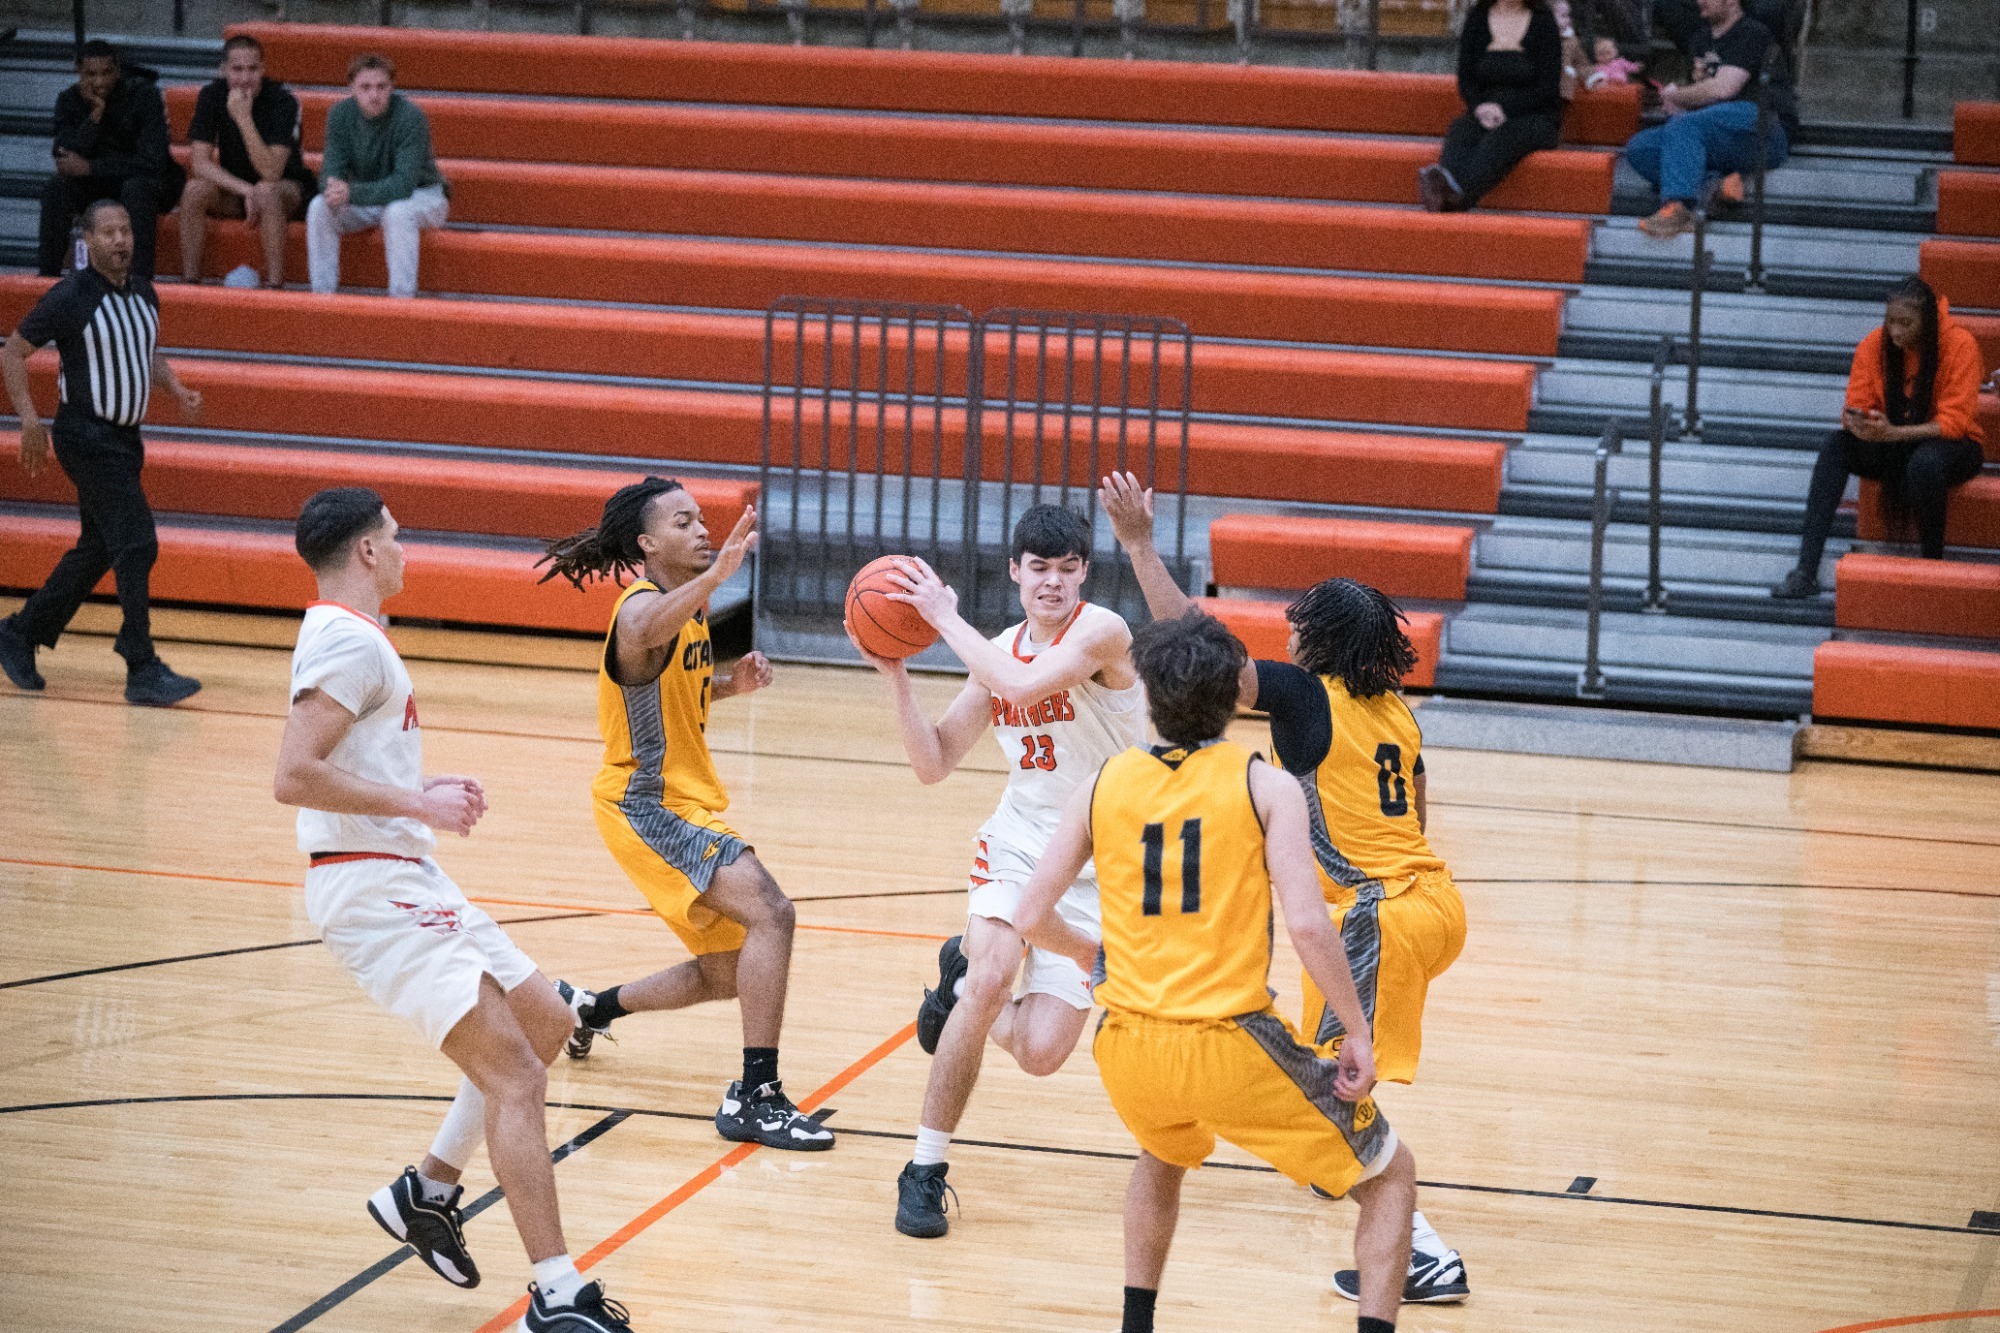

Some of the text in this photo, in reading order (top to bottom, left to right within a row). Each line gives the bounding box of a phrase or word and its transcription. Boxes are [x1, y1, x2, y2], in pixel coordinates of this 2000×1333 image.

[1020, 734, 1057, 771] 23
[1374, 743, 1408, 817] 0
[1140, 818, 1201, 916] 11
